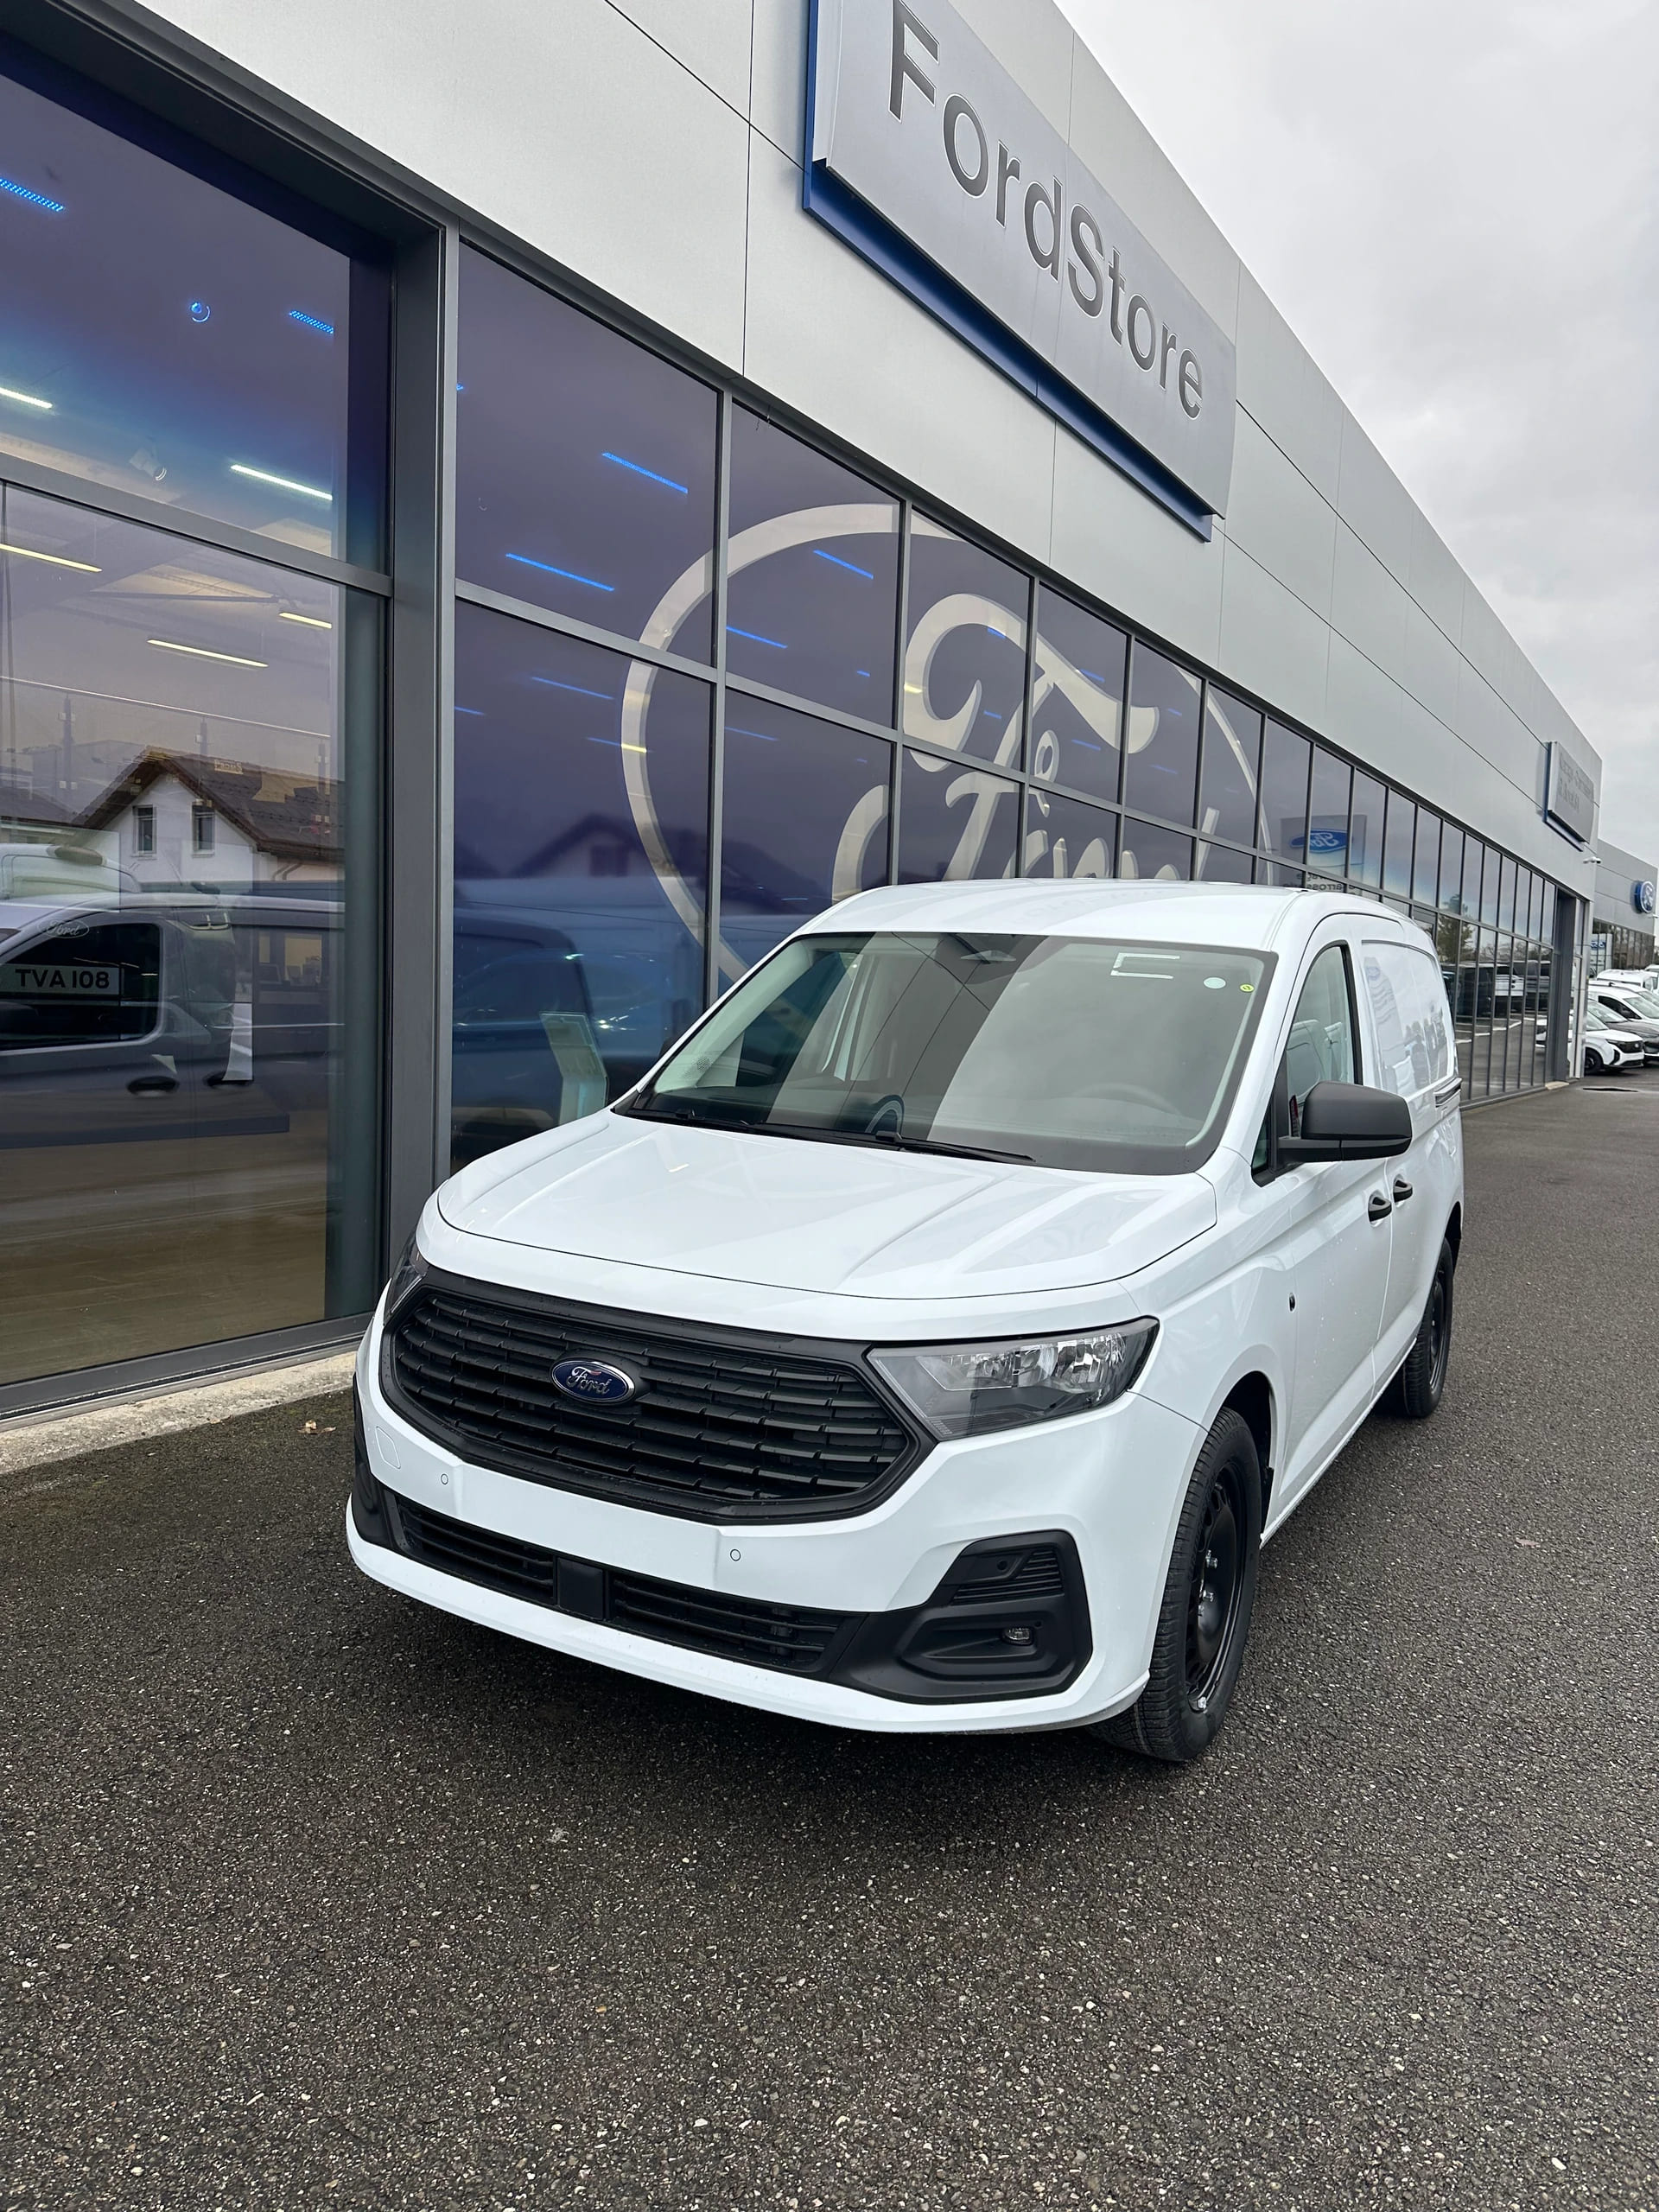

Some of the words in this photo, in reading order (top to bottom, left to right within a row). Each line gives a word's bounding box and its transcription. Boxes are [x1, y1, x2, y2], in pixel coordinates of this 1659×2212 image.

[888, 0, 1204, 420] FordStore
[15, 969, 66, 988] TVA
[72, 970, 110, 989] 108
[566, 1366, 612, 1395] Ford
